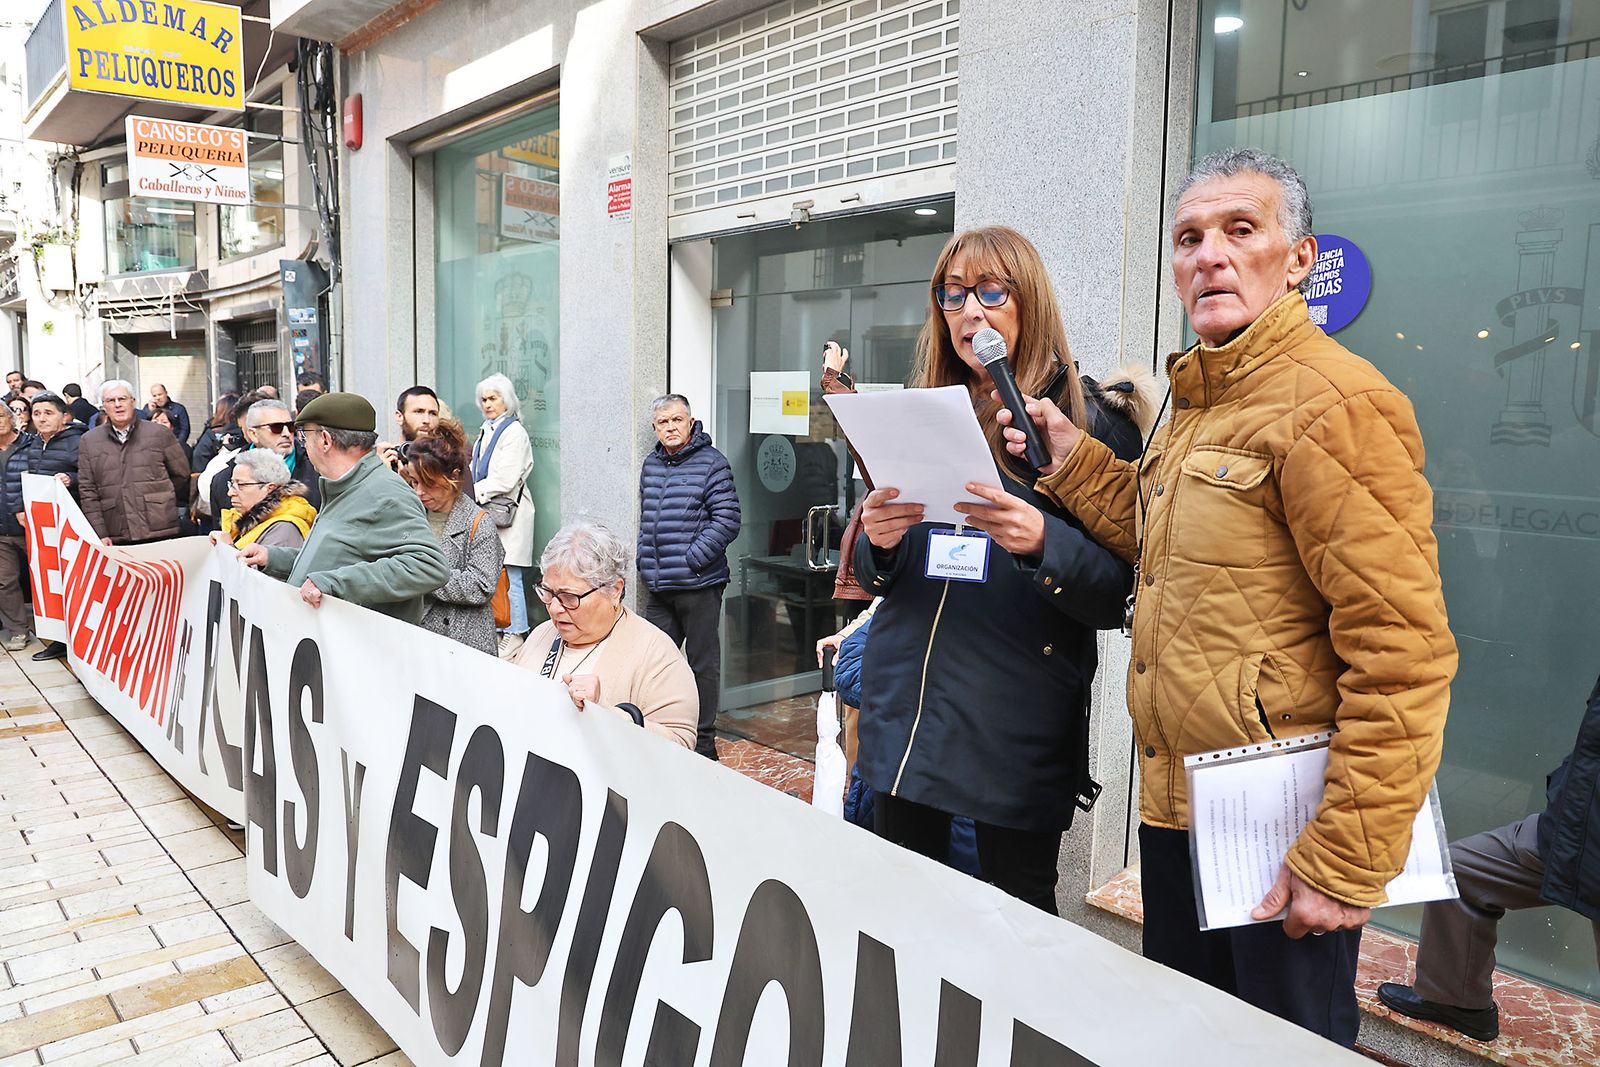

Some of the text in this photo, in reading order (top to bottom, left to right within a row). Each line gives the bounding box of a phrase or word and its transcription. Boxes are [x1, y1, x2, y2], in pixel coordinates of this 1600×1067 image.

[72, 0, 234, 54] ALDEMAR
[77, 48, 236, 98] PELUQUEROS
[138, 141, 243, 163] PELUQUERIA
[139, 177, 247, 199] Caballeros y Niños
[1313, 256, 1345, 275] HISTA
[1510, 288, 1567, 310] PLVS
[936, 563, 978, 572] ORGANIZACIÓN
[341, 746, 367, 942] Y
